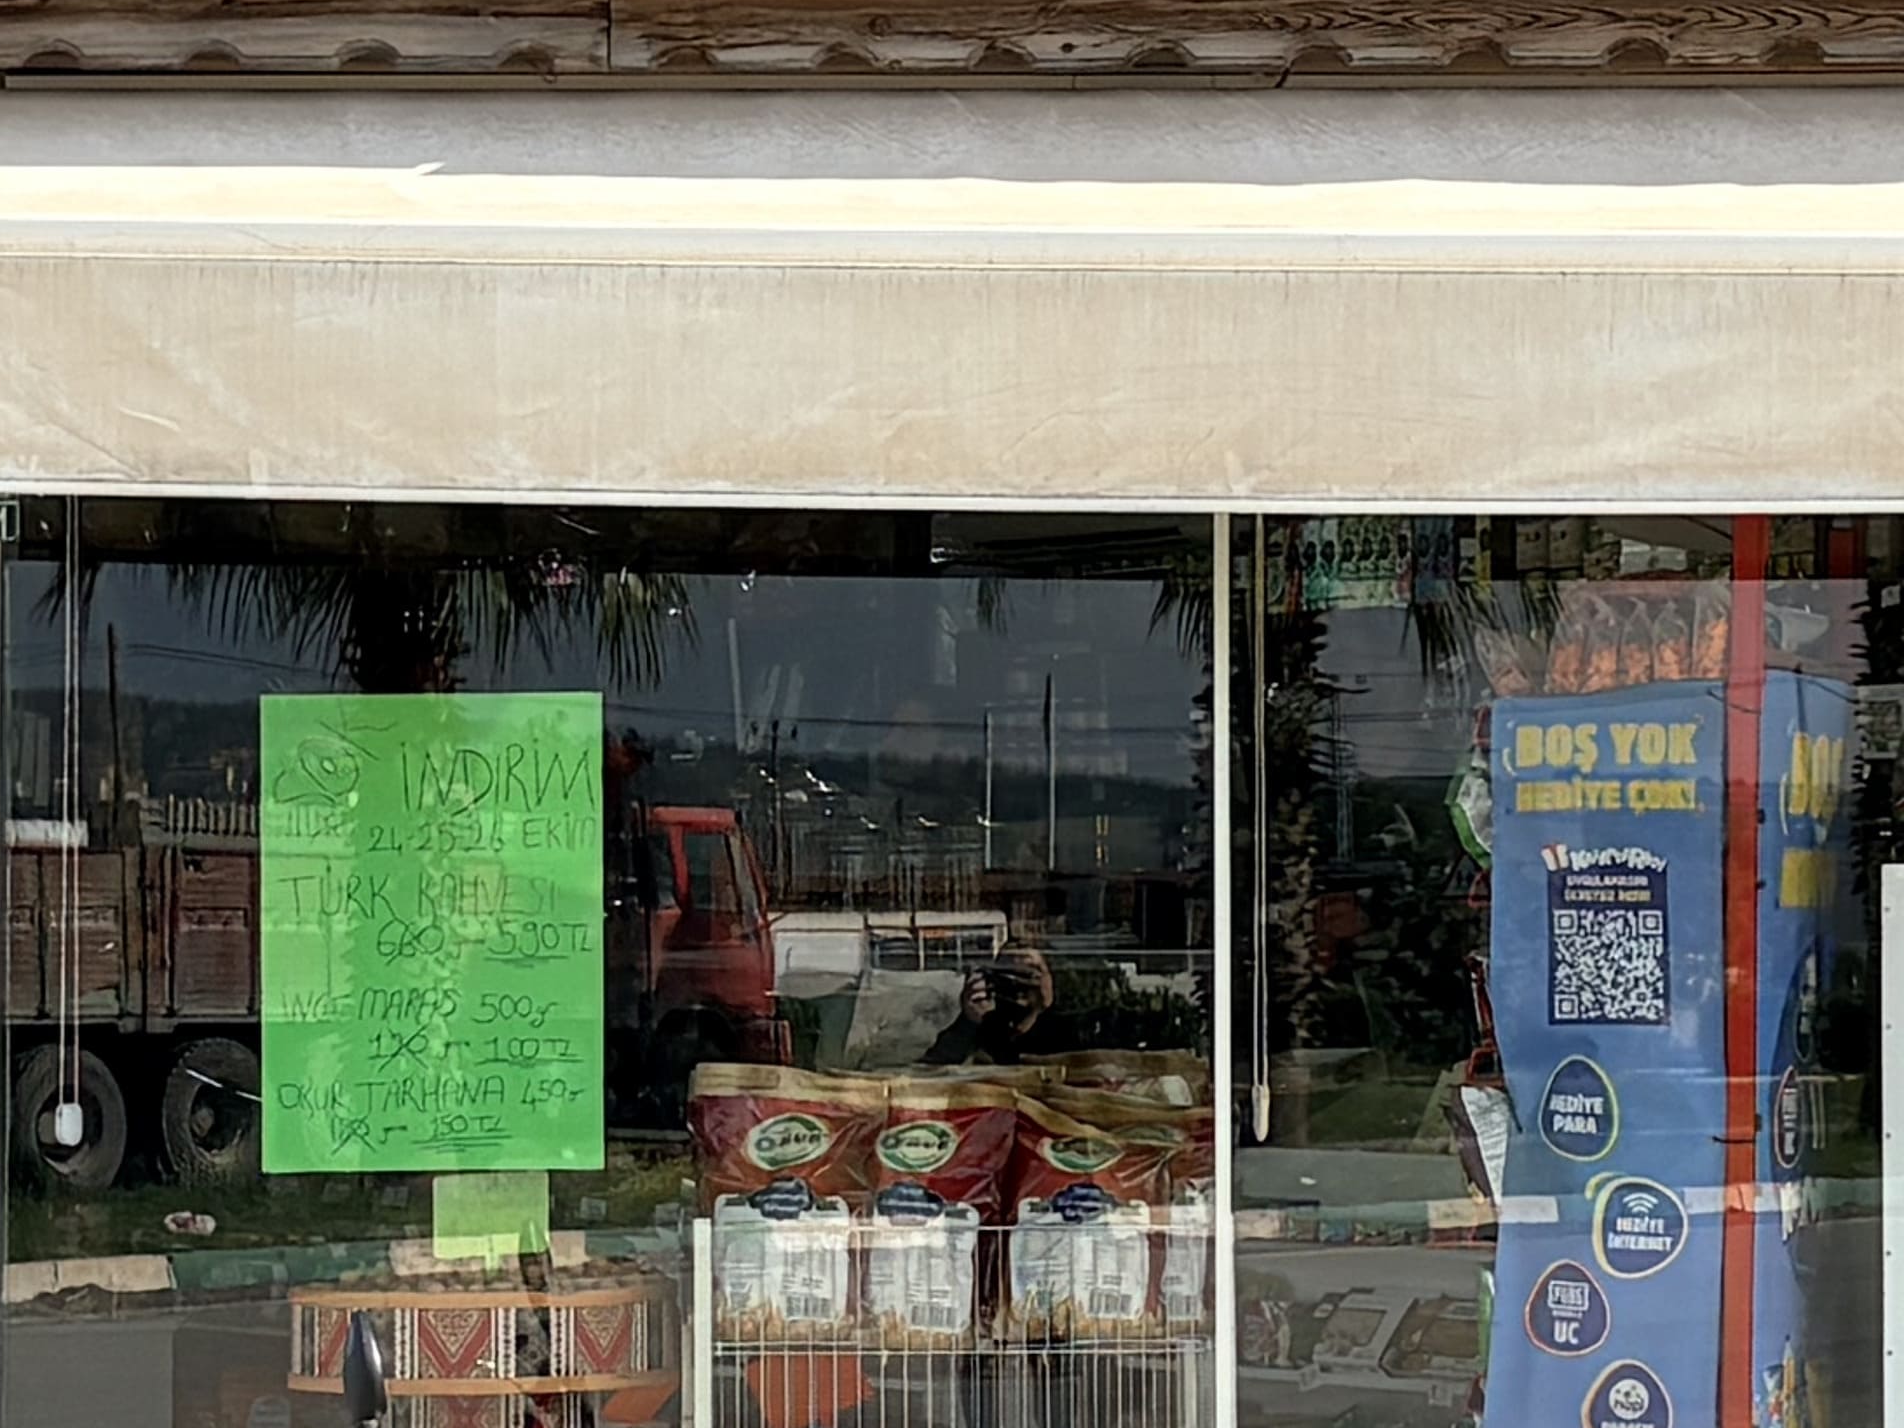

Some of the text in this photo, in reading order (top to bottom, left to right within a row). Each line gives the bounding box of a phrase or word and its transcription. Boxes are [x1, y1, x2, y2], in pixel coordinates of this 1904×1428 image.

[1515, 723, 1697, 774] BOŞ YOK
[355, 1076, 505, 1113] TARHANA
[1552, 1115, 1597, 1134] PARA
[1554, 1319, 1580, 1345] UC
